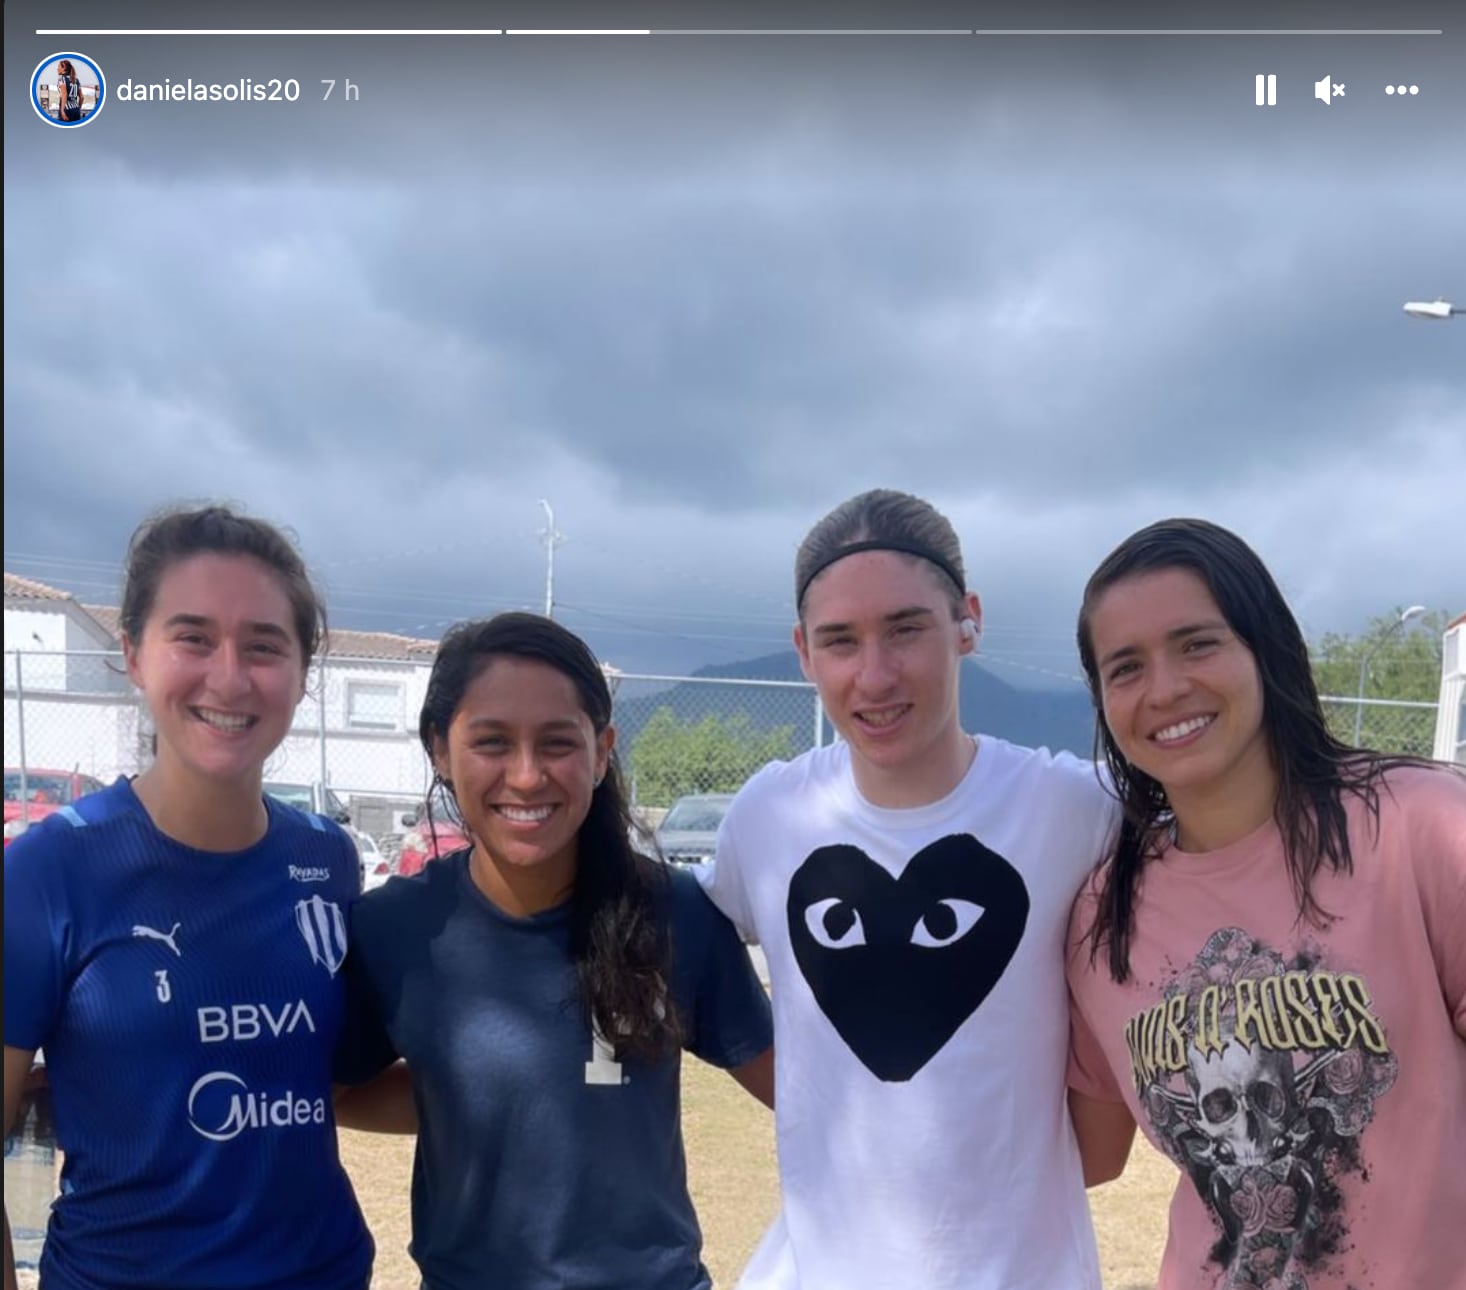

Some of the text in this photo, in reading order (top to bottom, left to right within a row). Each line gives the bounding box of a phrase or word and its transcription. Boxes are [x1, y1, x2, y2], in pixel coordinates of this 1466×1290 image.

[154, 970, 171, 1003] 3
[197, 999, 316, 1043] BBVA
[1233, 972, 1390, 1054] ROSES
[216, 1091, 326, 1133] Midea
